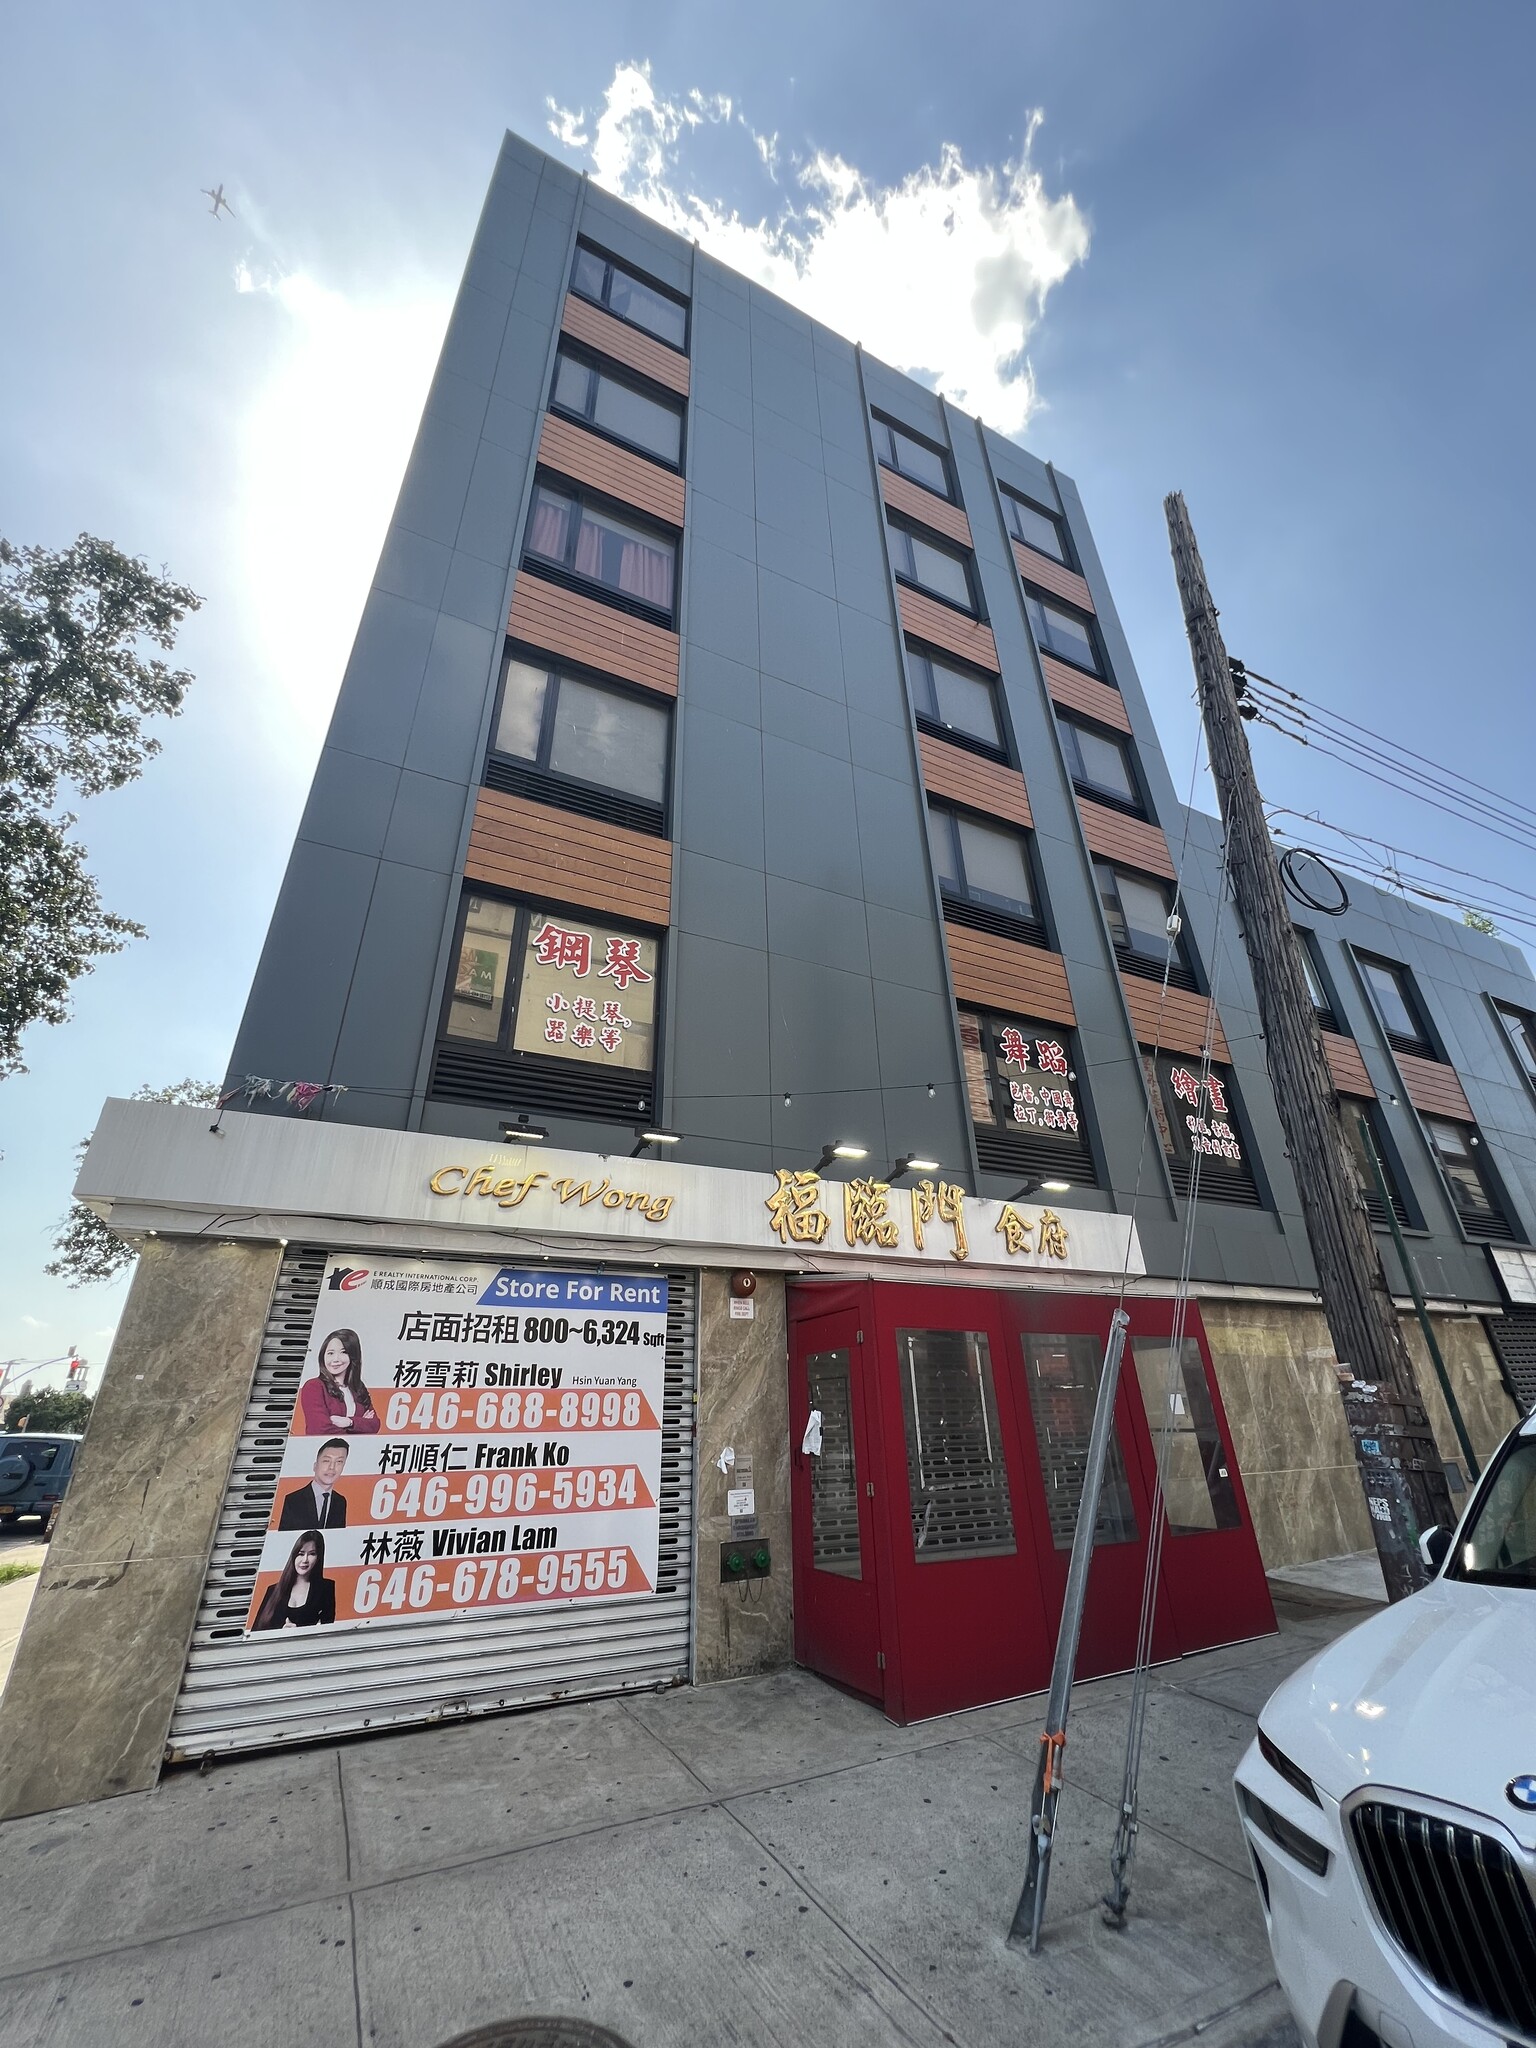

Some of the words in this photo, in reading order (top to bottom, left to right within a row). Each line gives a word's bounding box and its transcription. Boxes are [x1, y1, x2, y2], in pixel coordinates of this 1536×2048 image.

[532, 921, 653, 990] 鋼琴
[543, 1017, 623, 1052] 器樂等
[1000, 1027, 1068, 1076] 舞蹈
[429, 1165, 548, 1208] Chef
[552, 1178, 675, 1223] Wong
[766, 1168, 967, 1261] 福臨門
[995, 1204, 1070, 1259] 食府
[371, 1279, 479, 1295] 順成國際房地產公司
[405, 1273, 459, 1282] INTERNATIONAL
[495, 1276, 561, 1301] Store
[566, 1281, 604, 1303] For
[610, 1283, 661, 1304] Rent
[398, 1310, 519, 1345] 店面招租
[524, 1317, 640, 1349] 800~6,324
[643, 1331, 665, 1348] Sqft
[394, 1360, 478, 1389] 杨雪莉
[484, 1363, 562, 1390] Shirley
[572, 1375, 593, 1387] Hsin
[594, 1376, 616, 1387] Yuan
[617, 1376, 637, 1388] Yang
[385, 1391, 641, 1431] 646-688-8998
[378, 1444, 467, 1474] 柯順仁
[475, 1443, 539, 1469] Frank
[543, 1442, 570, 1467] Ko
[370, 1469, 637, 1520] 646-996-5934
[360, 1529, 424, 1565] 林薇
[432, 1528, 506, 1558] Vivian
[510, 1524, 558, 1552] Lam
[353, 1548, 628, 1615] 646-678-9555
